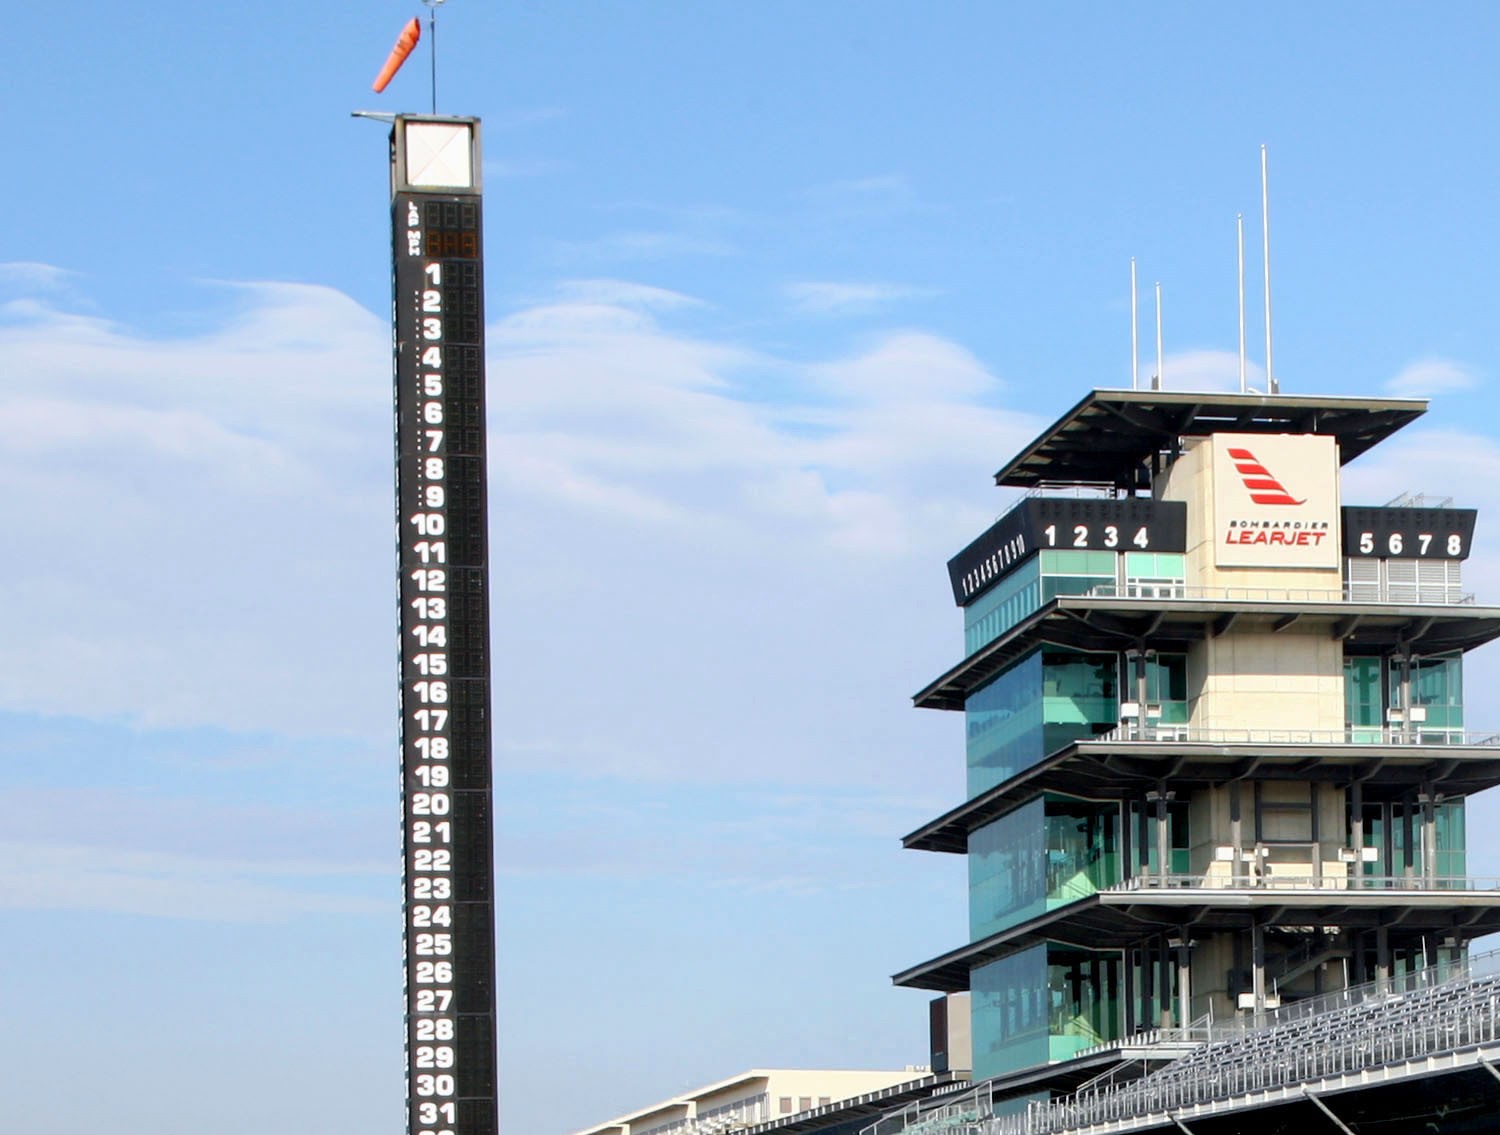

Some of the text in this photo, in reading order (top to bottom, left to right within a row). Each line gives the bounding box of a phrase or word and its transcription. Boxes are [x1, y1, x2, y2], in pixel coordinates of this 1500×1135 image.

[424, 262, 441, 285] 1
[422, 289, 442, 313] 2
[422, 317, 442, 341] 3
[422, 346, 442, 369] 4
[424, 374, 443, 397] 5
[424, 401, 443, 425] 6
[425, 429, 444, 452] 7
[425, 457, 444, 480] 8
[425, 485, 445, 508] 9
[410, 513, 445, 536] 10
[1229, 520, 1329, 529] BOMBARDIER
[1044, 525, 1149, 549] 1 2 3 4
[1225, 530, 1327, 546] LEARJET
[1360, 532, 1461, 556] 5 6 7 8
[413, 541, 446, 564] 11
[411, 569, 446, 592] 12
[411, 597, 447, 620] 13
[411, 624, 447, 648] 14
[412, 653, 448, 676] 15
[412, 681, 448, 704] 16
[413, 709, 448, 732] 17
[413, 736, 449, 760] 18
[414, 765, 449, 788] 19
[412, 792, 450, 816] 20
[412, 820, 451, 844] 21
[413, 848, 451, 872] 22
[413, 877, 451, 900] 23
[412, 905, 452, 928] 24
[415, 933, 452, 956] 25
[415, 961, 453, 984] 26
[416, 989, 453, 1012] 27
[416, 1018, 454, 1041] 28
[416, 1045, 454, 1069] 29
[416, 1074, 455, 1097] 30
[419, 1102, 455, 1125] 31
